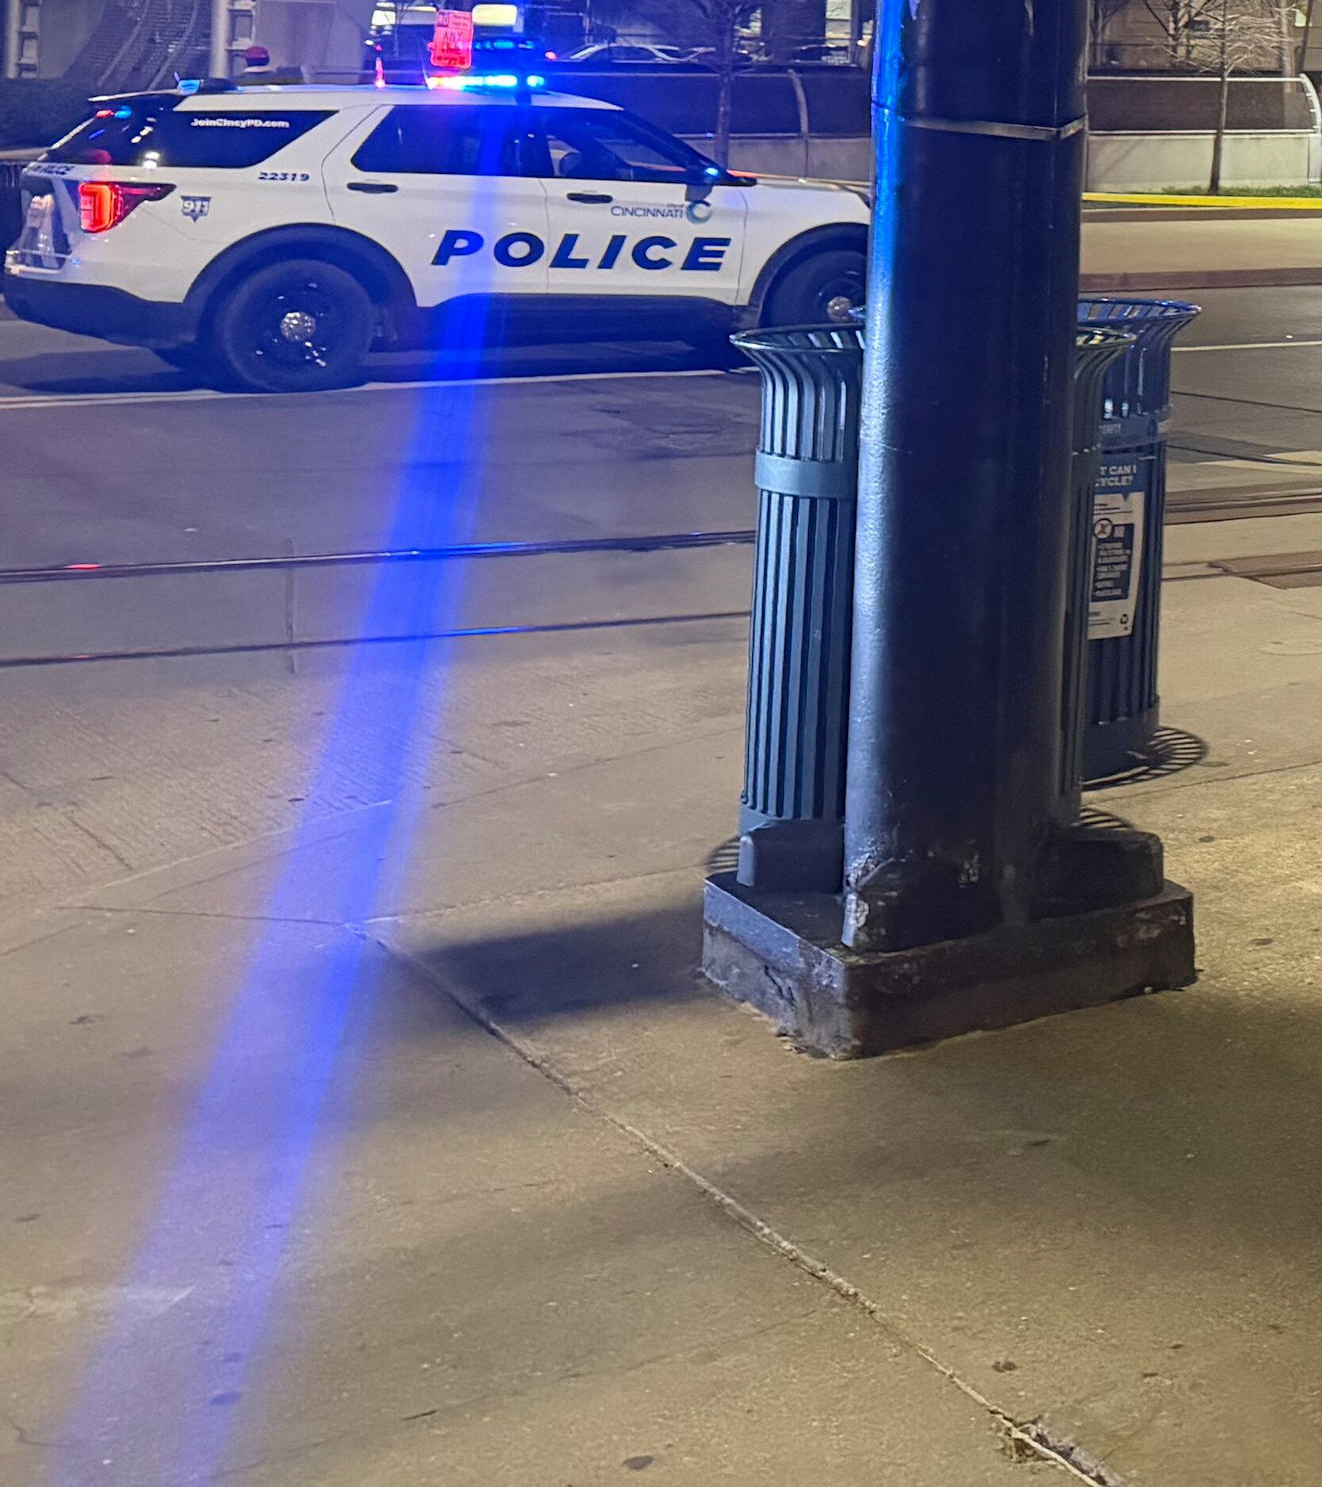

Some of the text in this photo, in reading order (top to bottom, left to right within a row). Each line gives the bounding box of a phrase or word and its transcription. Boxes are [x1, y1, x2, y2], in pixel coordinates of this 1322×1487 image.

[191, 118, 289, 129] JoinCincyPD.com
[258, 171, 310, 181] 22319
[183, 200, 209, 214] 911
[611, 206, 683, 218] CINCINNATI
[431, 229, 732, 272] POLICE
[1109, 465, 1131, 474] CAN
[1095, 476, 1134, 487] YCLE?
